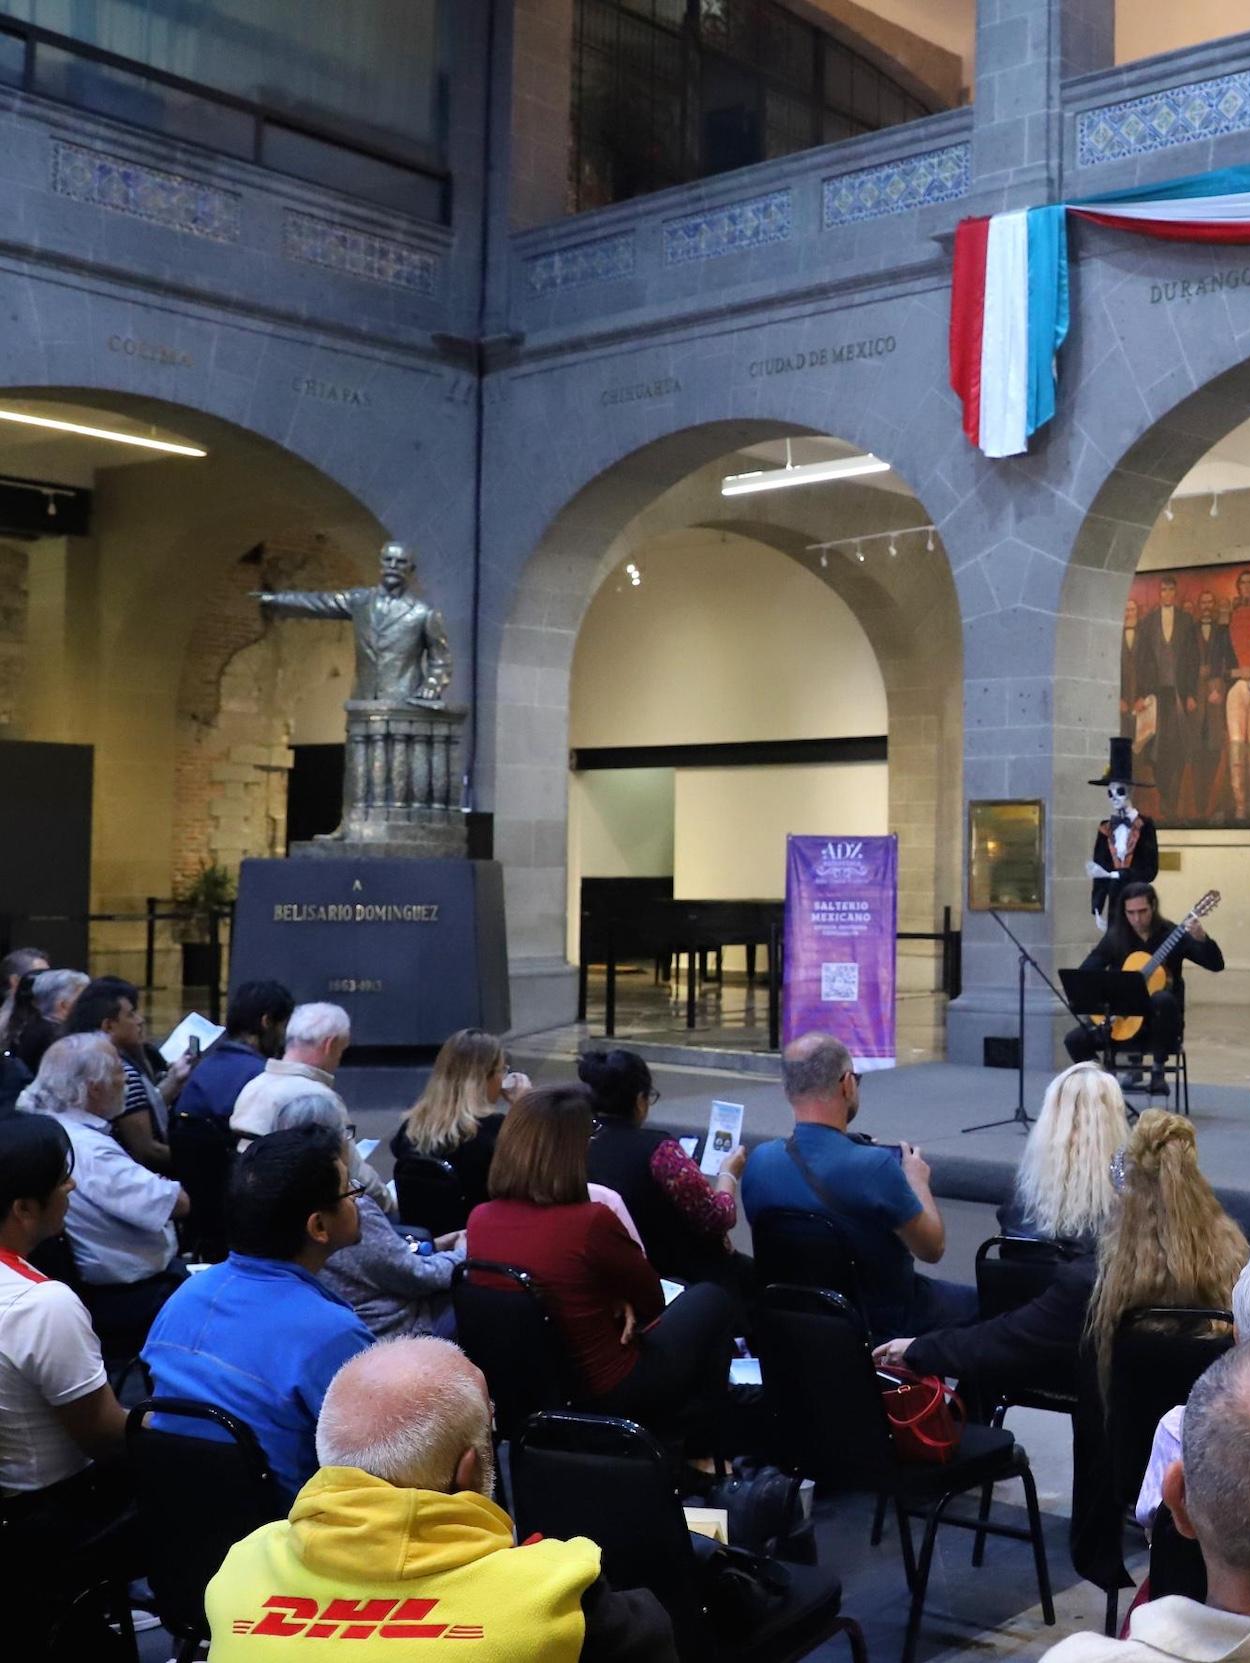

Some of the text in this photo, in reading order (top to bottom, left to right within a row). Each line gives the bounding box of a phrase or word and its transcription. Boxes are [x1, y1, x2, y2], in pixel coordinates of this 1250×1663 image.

[749, 353, 805, 378] CIUDAD
[809, 350, 828, 368] DE
[352, 879, 362, 891] A
[274, 904, 439, 921] BELISARIO DOMINGUEZ
[811, 912, 871, 922] MEXICANO
[250, 1594, 450, 1640] DHL
